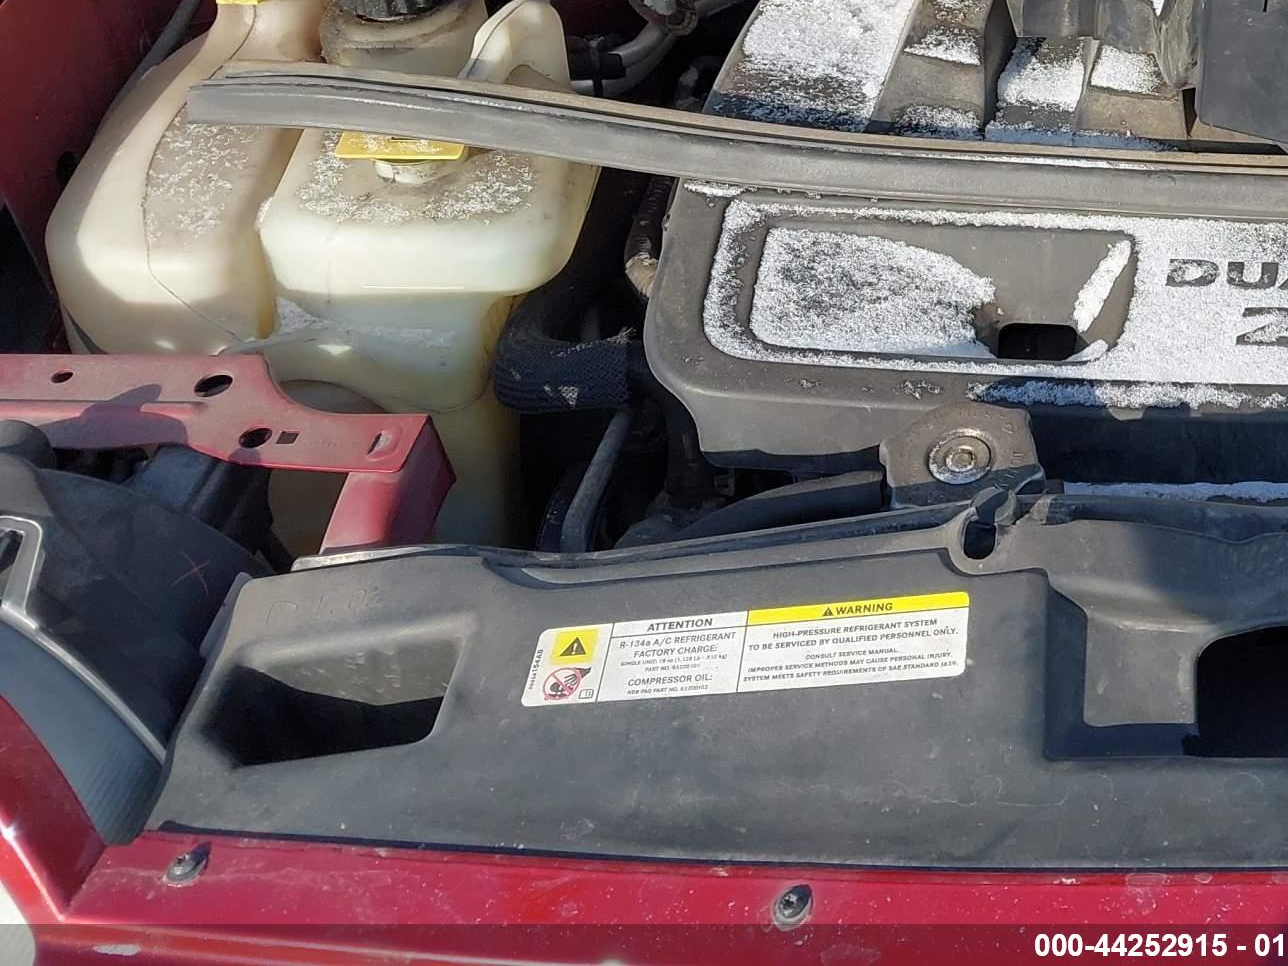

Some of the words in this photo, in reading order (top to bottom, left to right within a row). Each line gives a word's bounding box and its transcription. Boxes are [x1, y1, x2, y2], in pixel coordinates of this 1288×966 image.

[836, 602, 893, 616] WARNING
[647, 618, 713, 632] ATTENTION
[773, 627, 841, 639] HIGH-PRESSURE
[843, 622, 902, 634] REFRIGERANT
[904, 619, 937, 628] SYSTEM
[619, 639, 651, 650] R-134a
[653, 637, 672, 647] A/C
[674, 631, 736, 645] REFRIGERANT
[749, 643, 760, 651] TO
[762, 642, 773, 650] BE
[775, 639, 817, 649] SERVICED
[819, 638, 831, 646] BY
[833, 635, 878, 646] QUALIFIED
[880, 630, 931, 641] PERSONNEL
[633, 648, 675, 659] FACTORY
[677, 645, 718, 655] CHARGE:
[838, 650, 867, 658] SERVICE
[743, 674, 770, 682] SYSTEM
[772, 672, 794, 680] MEETS
[796, 670, 821, 678] SAFETY
[823, 666, 876, 676] REQUIREMENTS
[902, 661, 939, 670] STANDARD
[748, 665, 783, 673] IMPROPER
[815, 660, 848, 668] METHODS
[866, 656, 888, 664] CAUSE
[890, 654, 925, 662] PERSONAL
[627, 676, 692, 687] COMPRESSOR
[694, 674, 713, 682] OIL:
